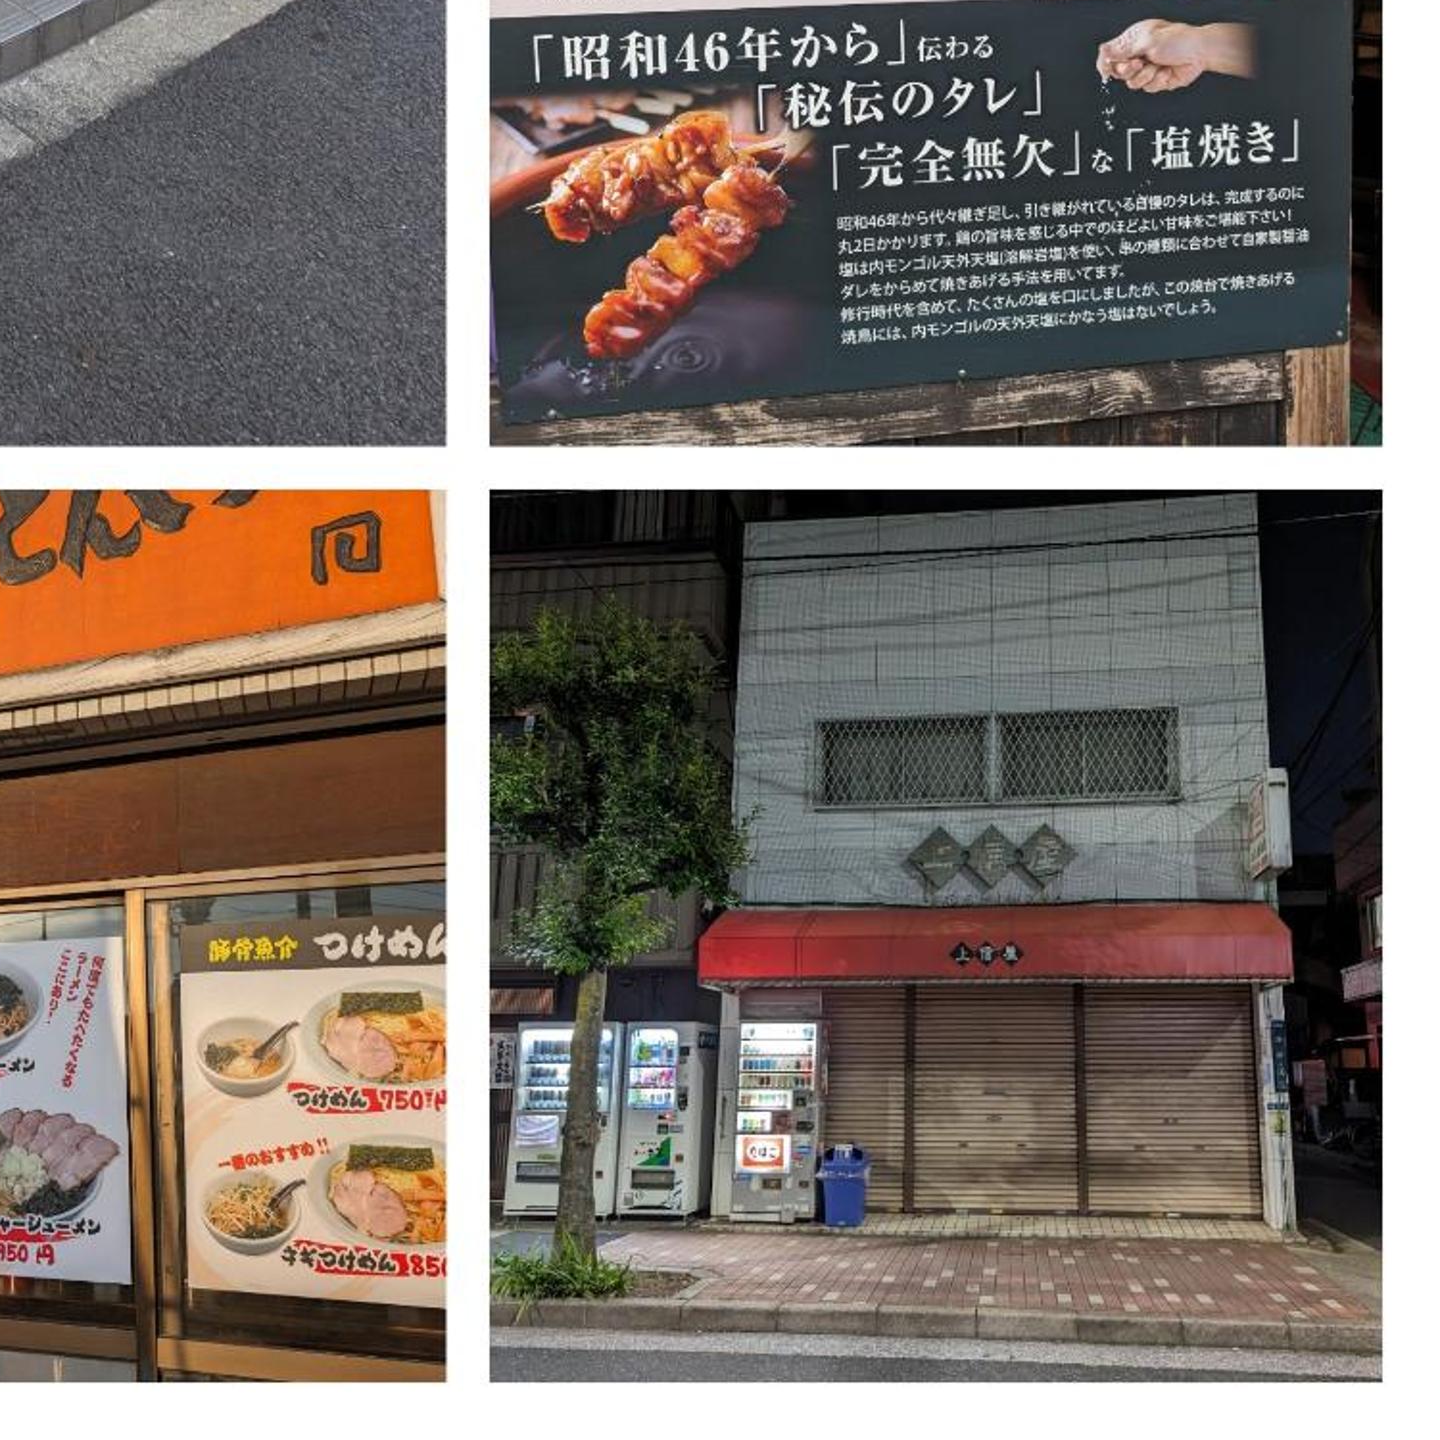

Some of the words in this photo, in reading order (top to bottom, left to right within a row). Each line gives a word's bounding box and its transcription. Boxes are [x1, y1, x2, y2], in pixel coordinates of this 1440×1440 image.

[532, 18, 995, 83] 「昭和46年から」伝わる
[756, 70, 1044, 132] 「秘伝のタレ」
[832, 118, 1300, 192] 「完全無欠」な「塩焼き」
[209, 934, 298, 962] 豚骨魚介
[293, 1090, 367, 1108] つけめん
